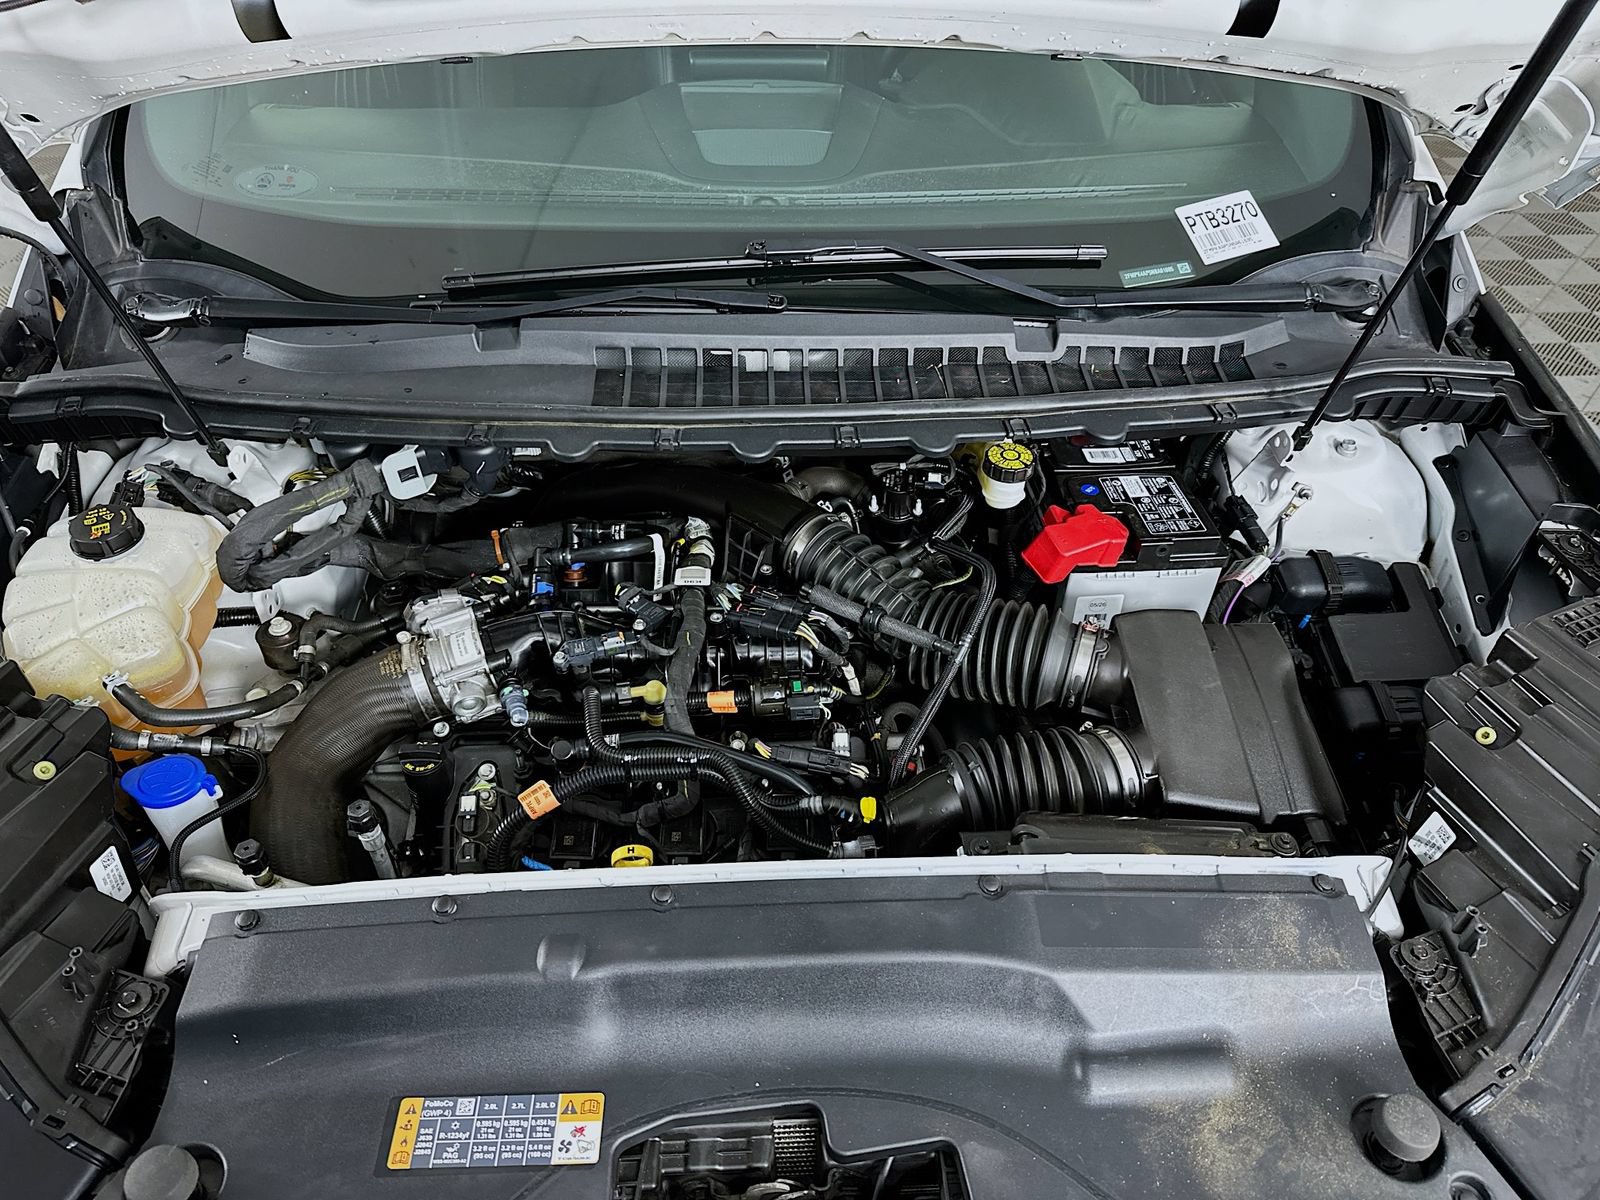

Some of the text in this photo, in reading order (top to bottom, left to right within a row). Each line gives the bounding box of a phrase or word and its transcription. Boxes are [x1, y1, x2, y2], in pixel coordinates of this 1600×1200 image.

[1184, 200, 1258, 234] PTB3270
[627, 846, 634, 854] H
[422, 1109, 452, 1117] (GWP 4)
[493, 1120, 501, 1128] kg
[439, 1132, 470, 1140] R-1234yf
